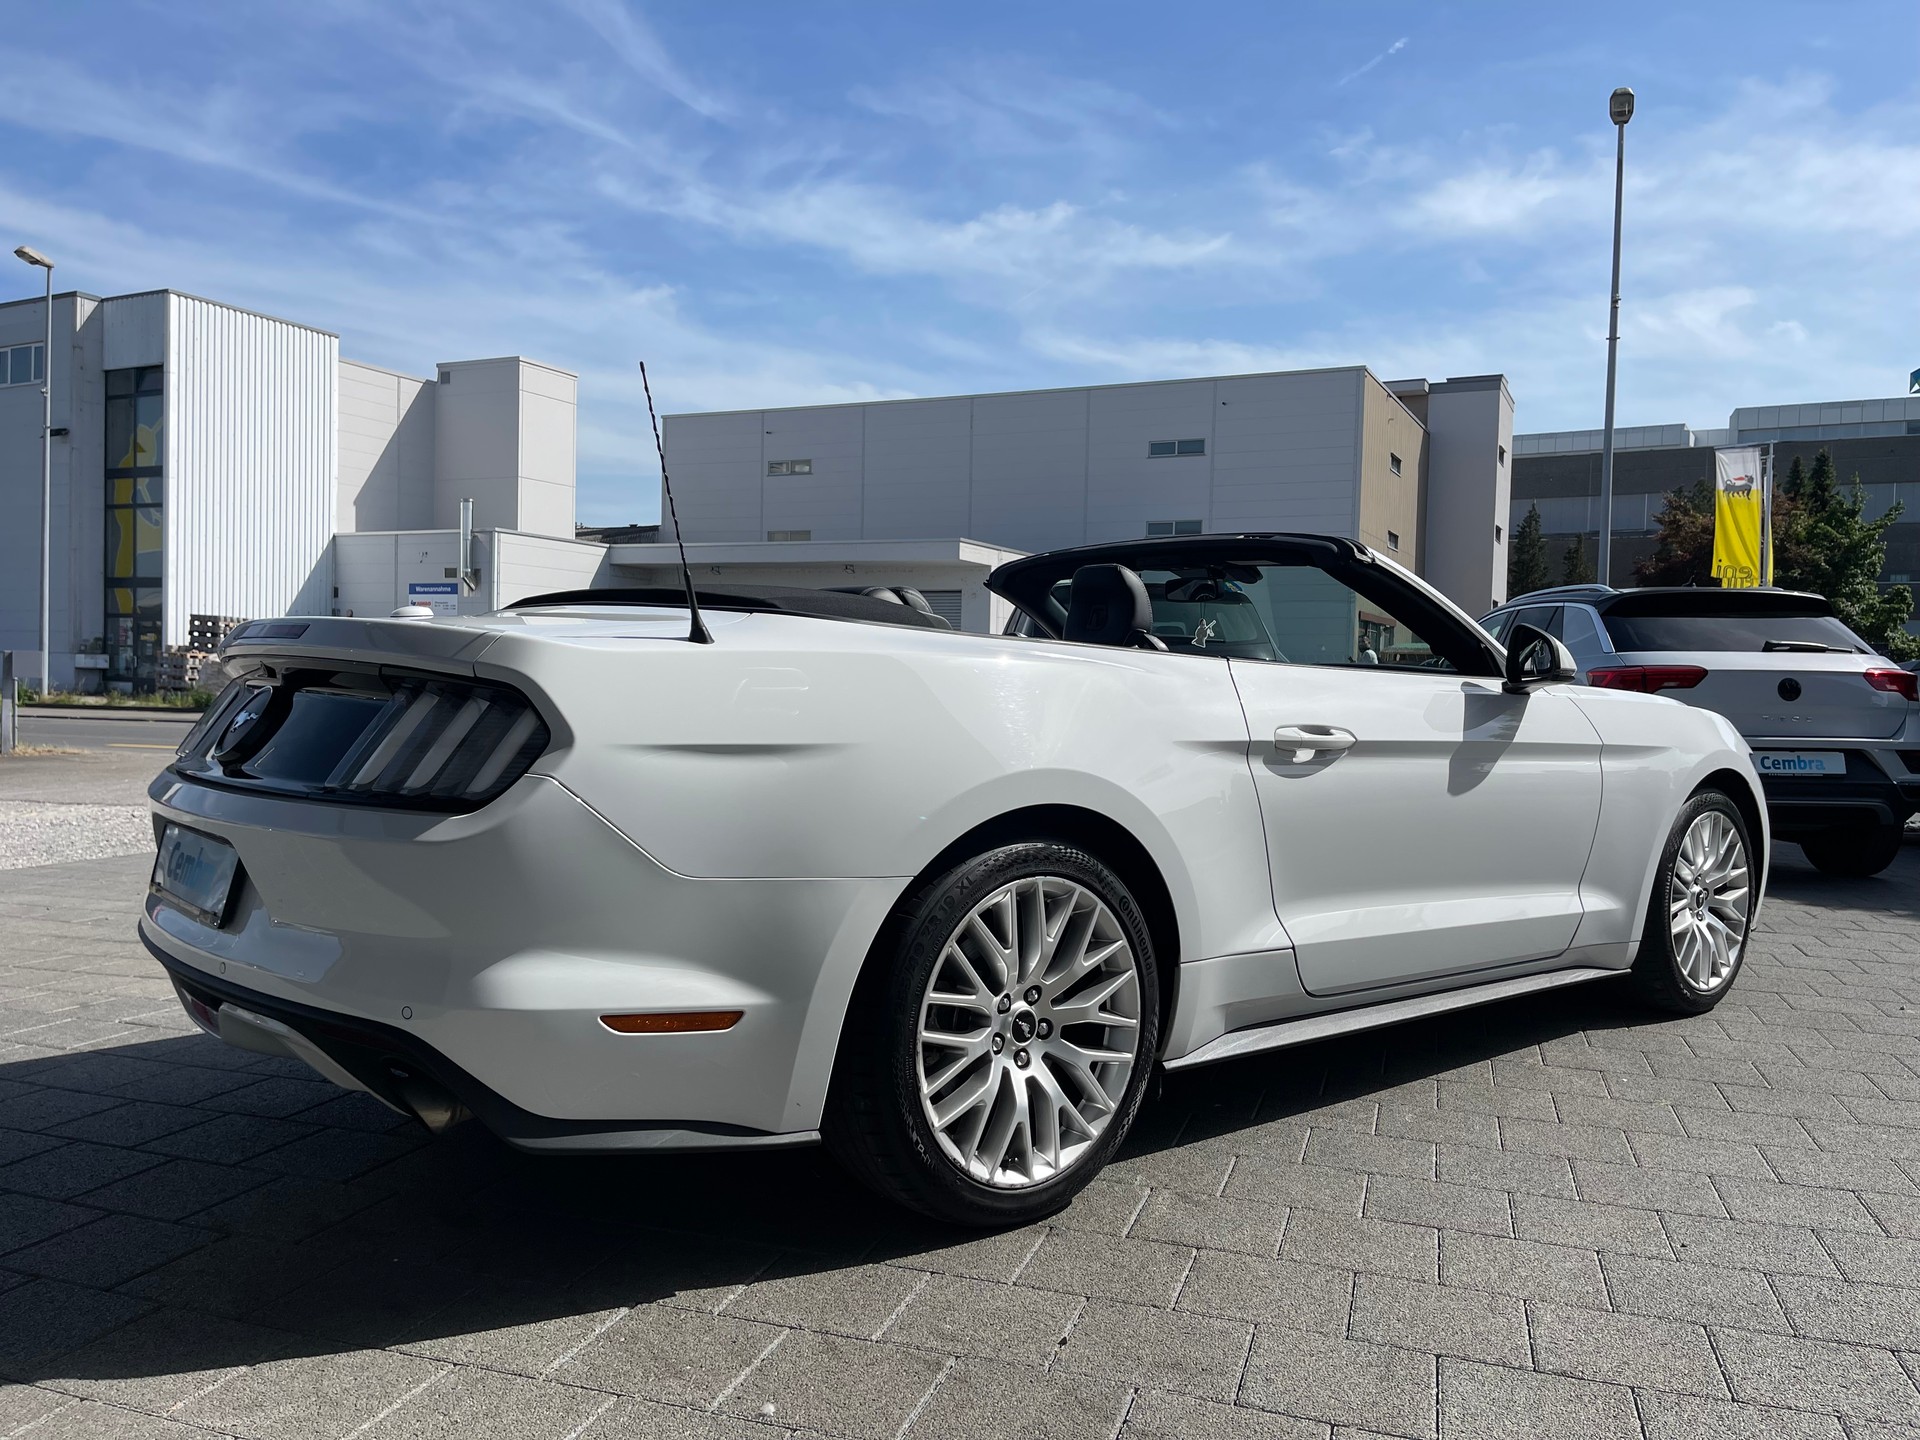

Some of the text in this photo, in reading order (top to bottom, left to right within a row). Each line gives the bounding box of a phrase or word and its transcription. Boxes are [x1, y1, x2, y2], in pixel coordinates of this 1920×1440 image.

[1760, 755, 1826, 770] Cembra
[167, 841, 216, 897] Cemb
[955, 876, 976, 896] XL
